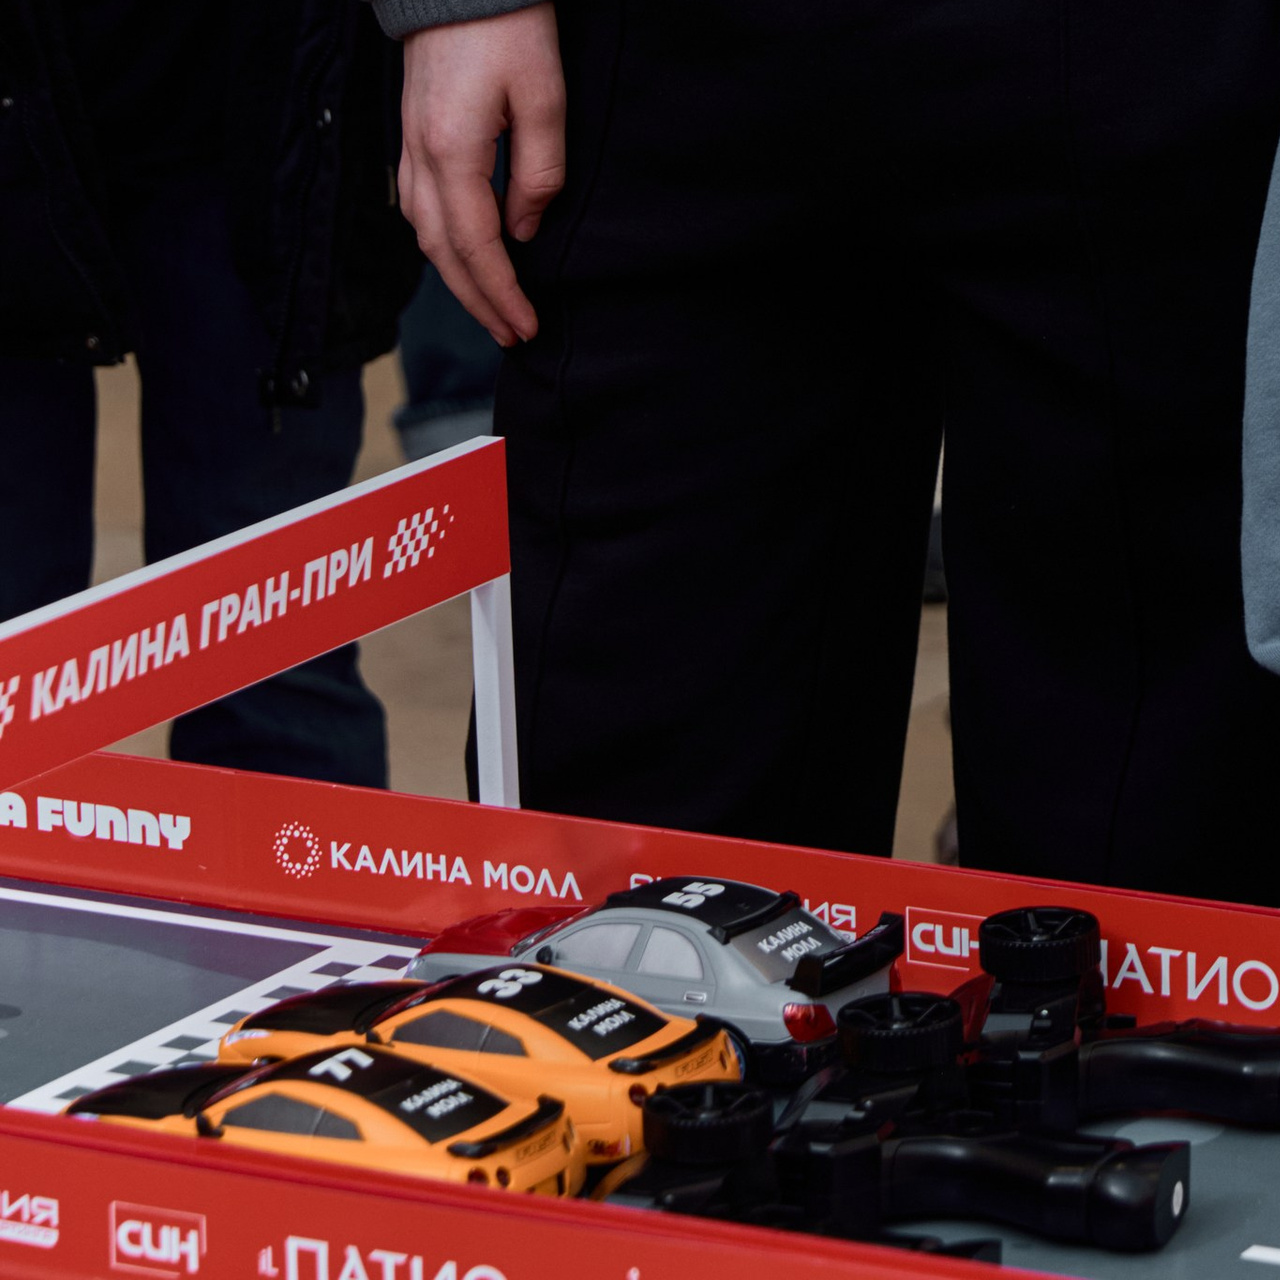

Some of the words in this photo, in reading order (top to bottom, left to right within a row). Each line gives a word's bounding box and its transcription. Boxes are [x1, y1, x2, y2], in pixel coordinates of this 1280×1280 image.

[30, 613, 190, 721] КАЛИНА
[199, 537, 374, 649] ГРАН-ПРИ
[331, 841, 472, 886] КАЛИНА
[484, 861, 583, 901] МОЛЛ
[661, 881, 726, 909] 55
[757, 921, 813, 954] КАЛИНА
[781, 936, 822, 963] МОЛЛ
[477, 968, 543, 998] 33
[567, 997, 626, 1031] КАЛИНА
[308, 1047, 374, 1081] 77
[286, 1236, 507, 1280] ПАТ
